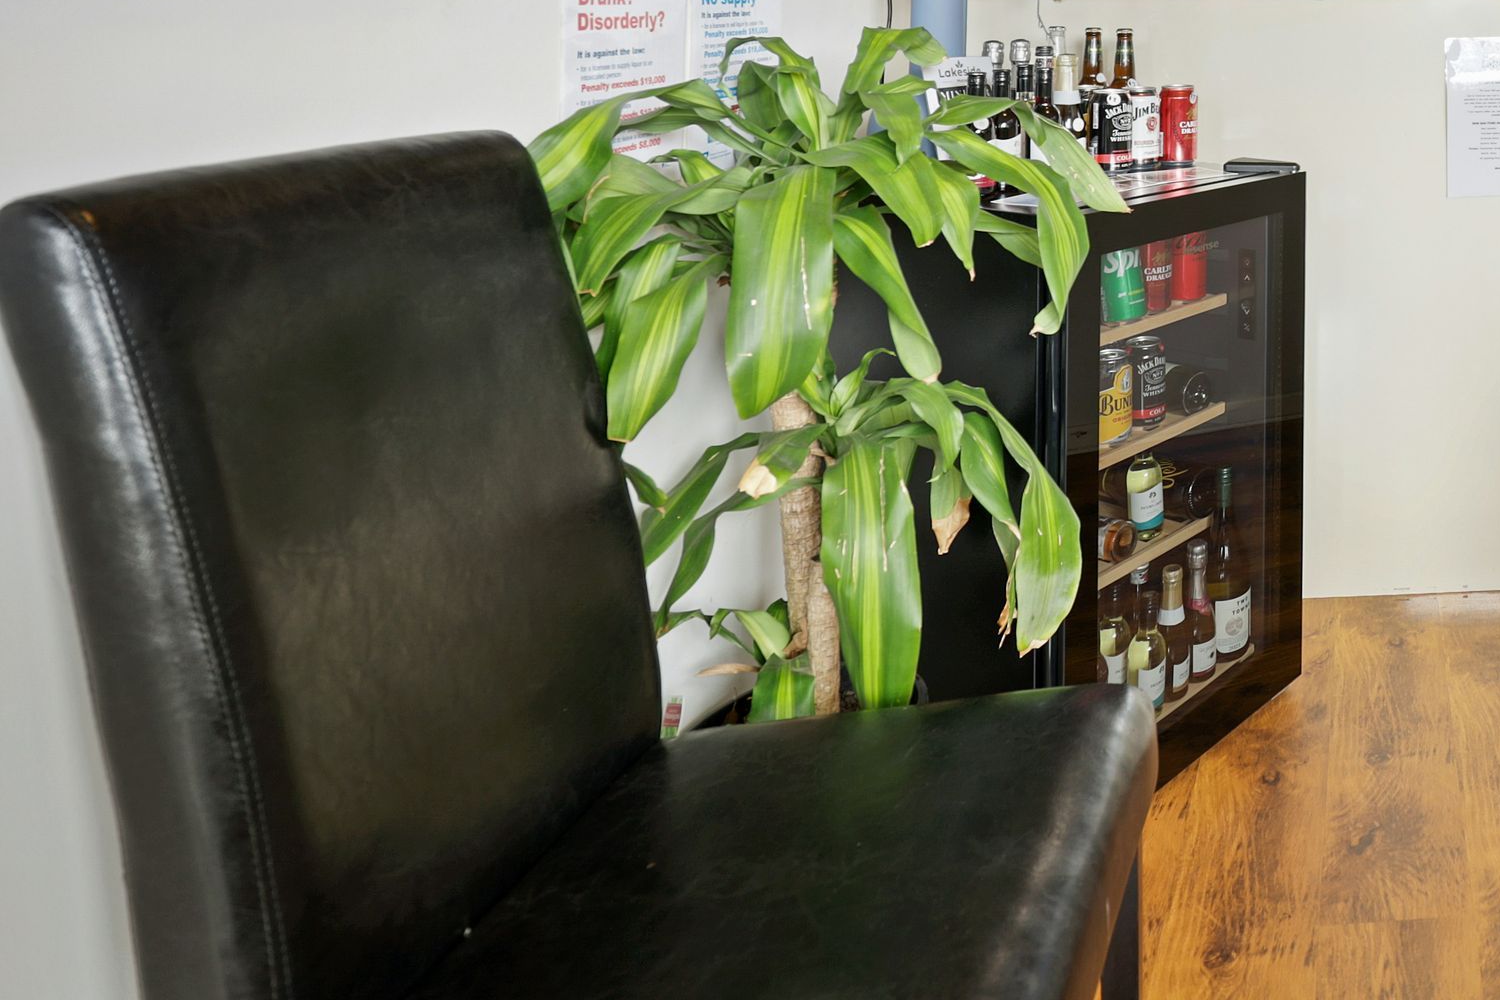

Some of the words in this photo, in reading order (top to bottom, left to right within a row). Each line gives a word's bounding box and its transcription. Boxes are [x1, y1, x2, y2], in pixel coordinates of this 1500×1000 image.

[577, 10, 666, 33] Disorderly?
[593, 48, 618, 59] against
[619, 48, 630, 56] the
[581, 83, 609, 93] Penalty
[611, 80, 639, 90] exceeds
[1133, 105, 1149, 121] JIM
[1137, 359, 1155, 375] JACK
